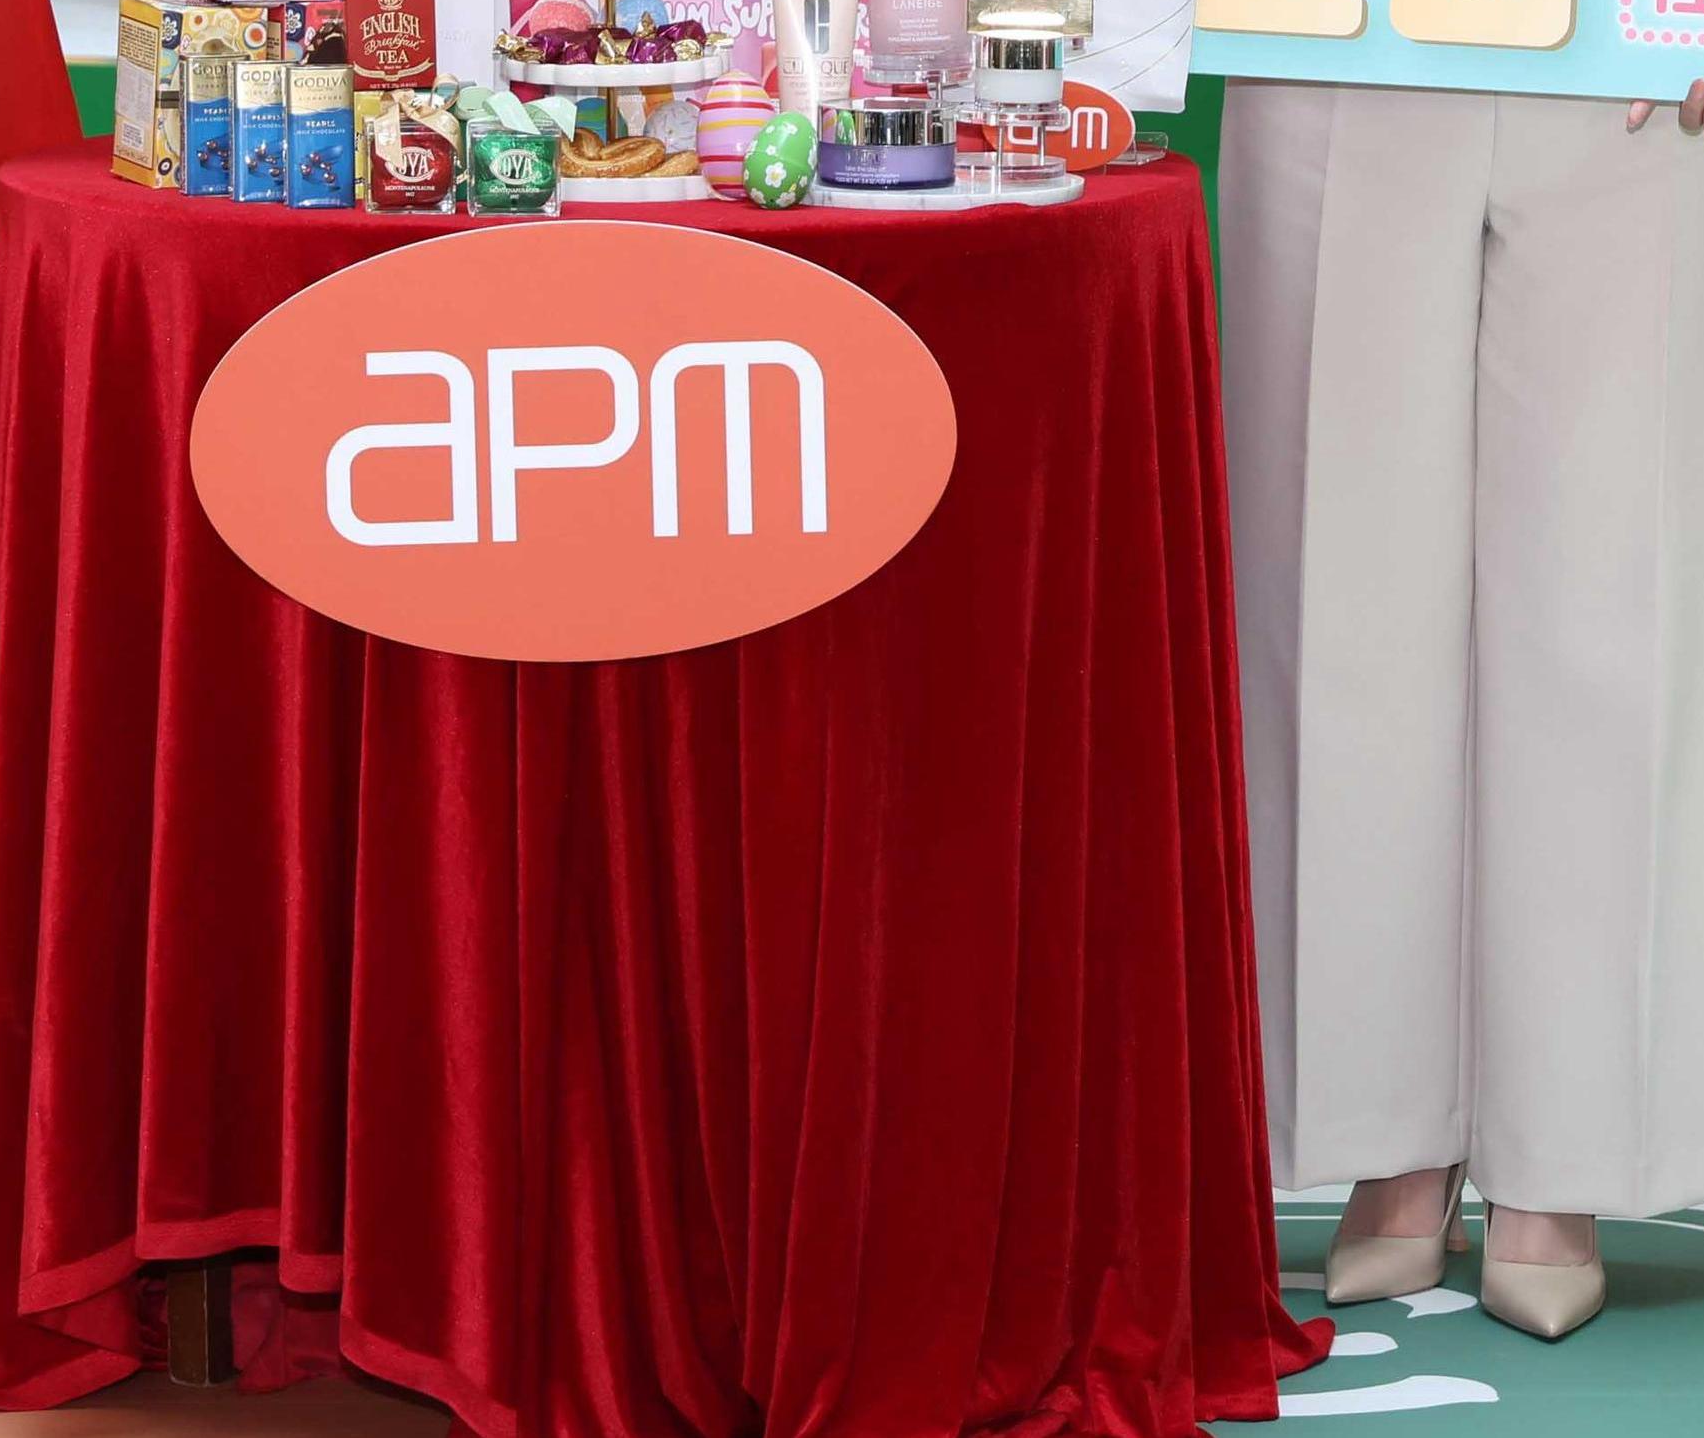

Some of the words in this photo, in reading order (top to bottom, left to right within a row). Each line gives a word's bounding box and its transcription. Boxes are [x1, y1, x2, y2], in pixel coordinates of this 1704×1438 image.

[360, 12, 421, 41] ENGLISH
[364, 34, 421, 55] Breakfast
[376, 49, 408, 64] TEA
[193, 64, 227, 75] GODI
[294, 77, 348, 89] GODIVA
